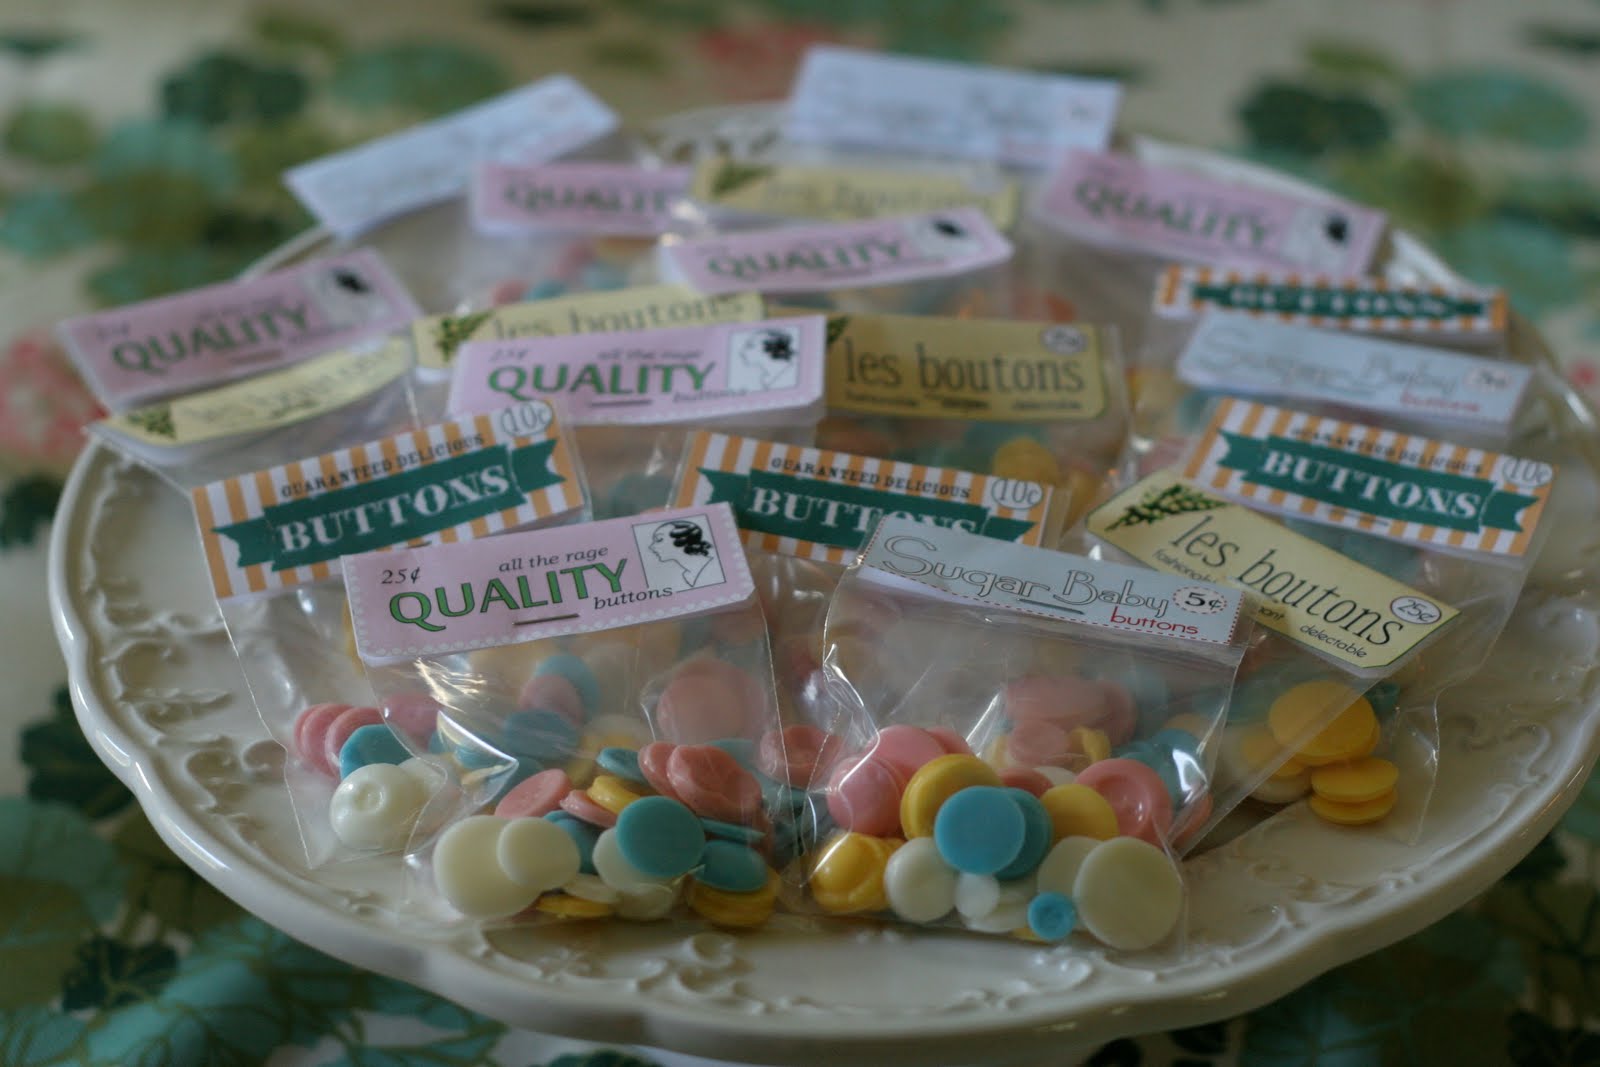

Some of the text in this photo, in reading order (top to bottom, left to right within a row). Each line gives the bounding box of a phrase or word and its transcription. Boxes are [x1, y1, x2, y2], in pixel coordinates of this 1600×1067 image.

[706, 237, 900, 280] QUALITY
[111, 302, 311, 376] QUALITY
[487, 361, 716, 401] QUALITY
[844, 338, 1085, 393] les boutons
[280, 433, 486, 497] GUARANTEED DELICIOUS
[770, 456, 972, 499] GUARANTEED DELICIOUS
[1262, 450, 1482, 519] BUTTONS
[276, 464, 510, 553] BUTTONS
[381, 566, 421, 585] 25¢
[498, 545, 609, 573] all the rage
[882, 535, 1170, 618] Sugar Baby
[389, 558, 628, 632] QUALITY
[593, 587, 674, 611] buttons
[1169, 515, 1405, 647] les boutons
[1184, 592, 1222, 611] 5¢
[1110, 606, 1199, 635] buttons
[1396, 599, 1437, 622] 25¢
[1300, 623, 1367, 659] delectable
